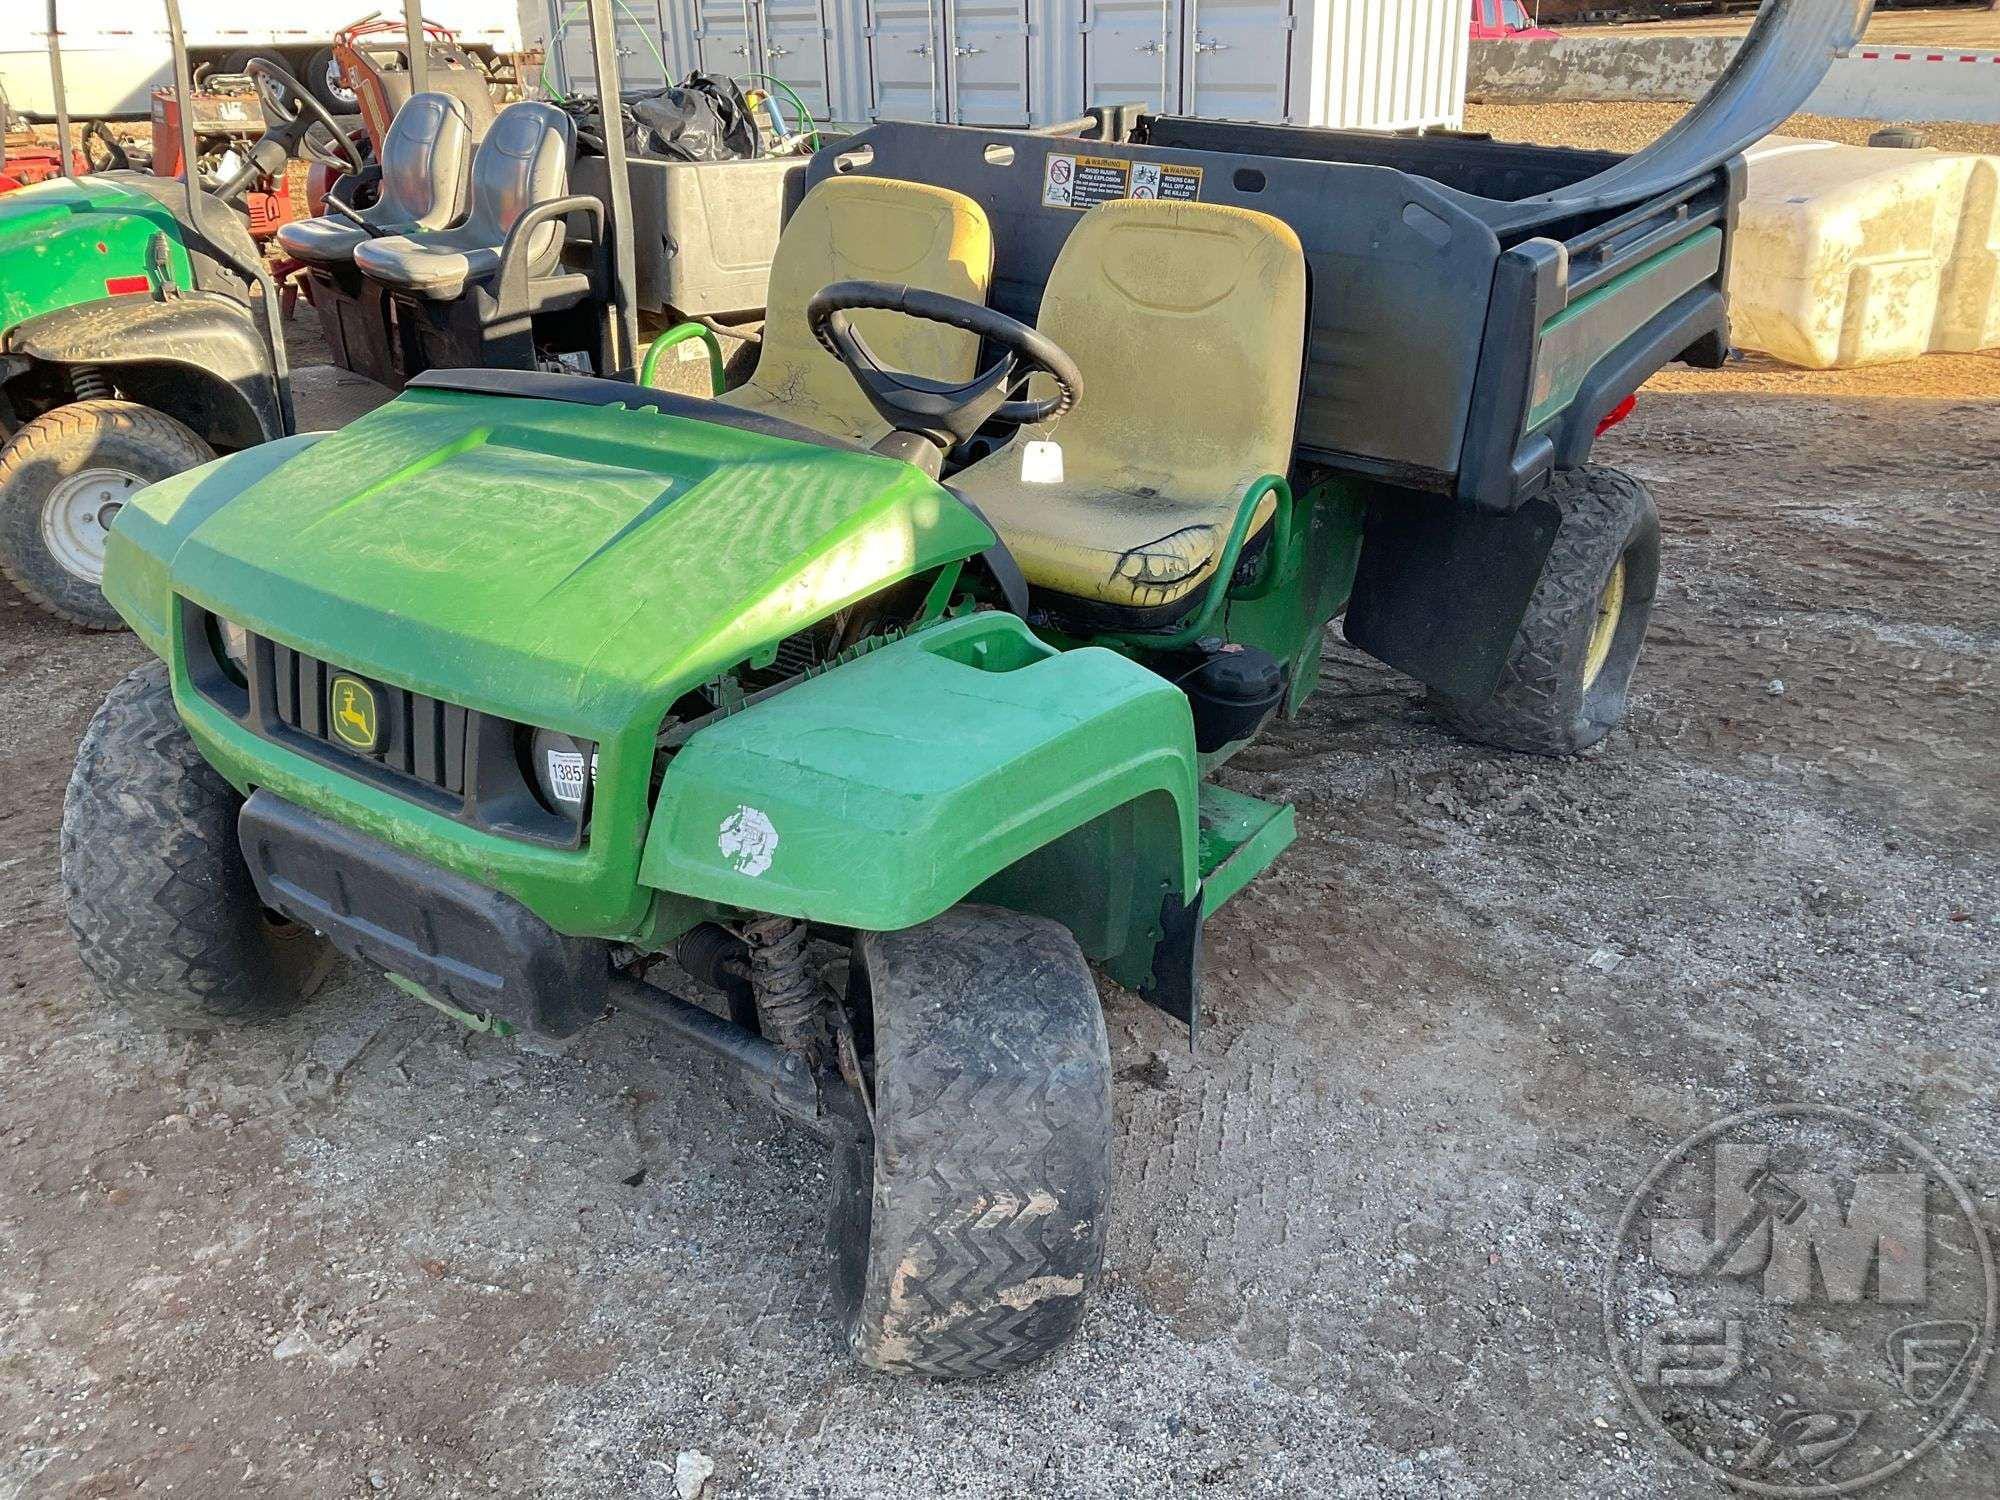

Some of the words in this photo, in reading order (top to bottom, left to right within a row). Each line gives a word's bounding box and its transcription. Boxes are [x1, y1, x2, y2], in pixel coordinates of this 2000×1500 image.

[1091, 159, 1121, 168] WARNING
[1169, 166, 1201, 176] WARNING
[1164, 175, 1183, 183] RIDERS
